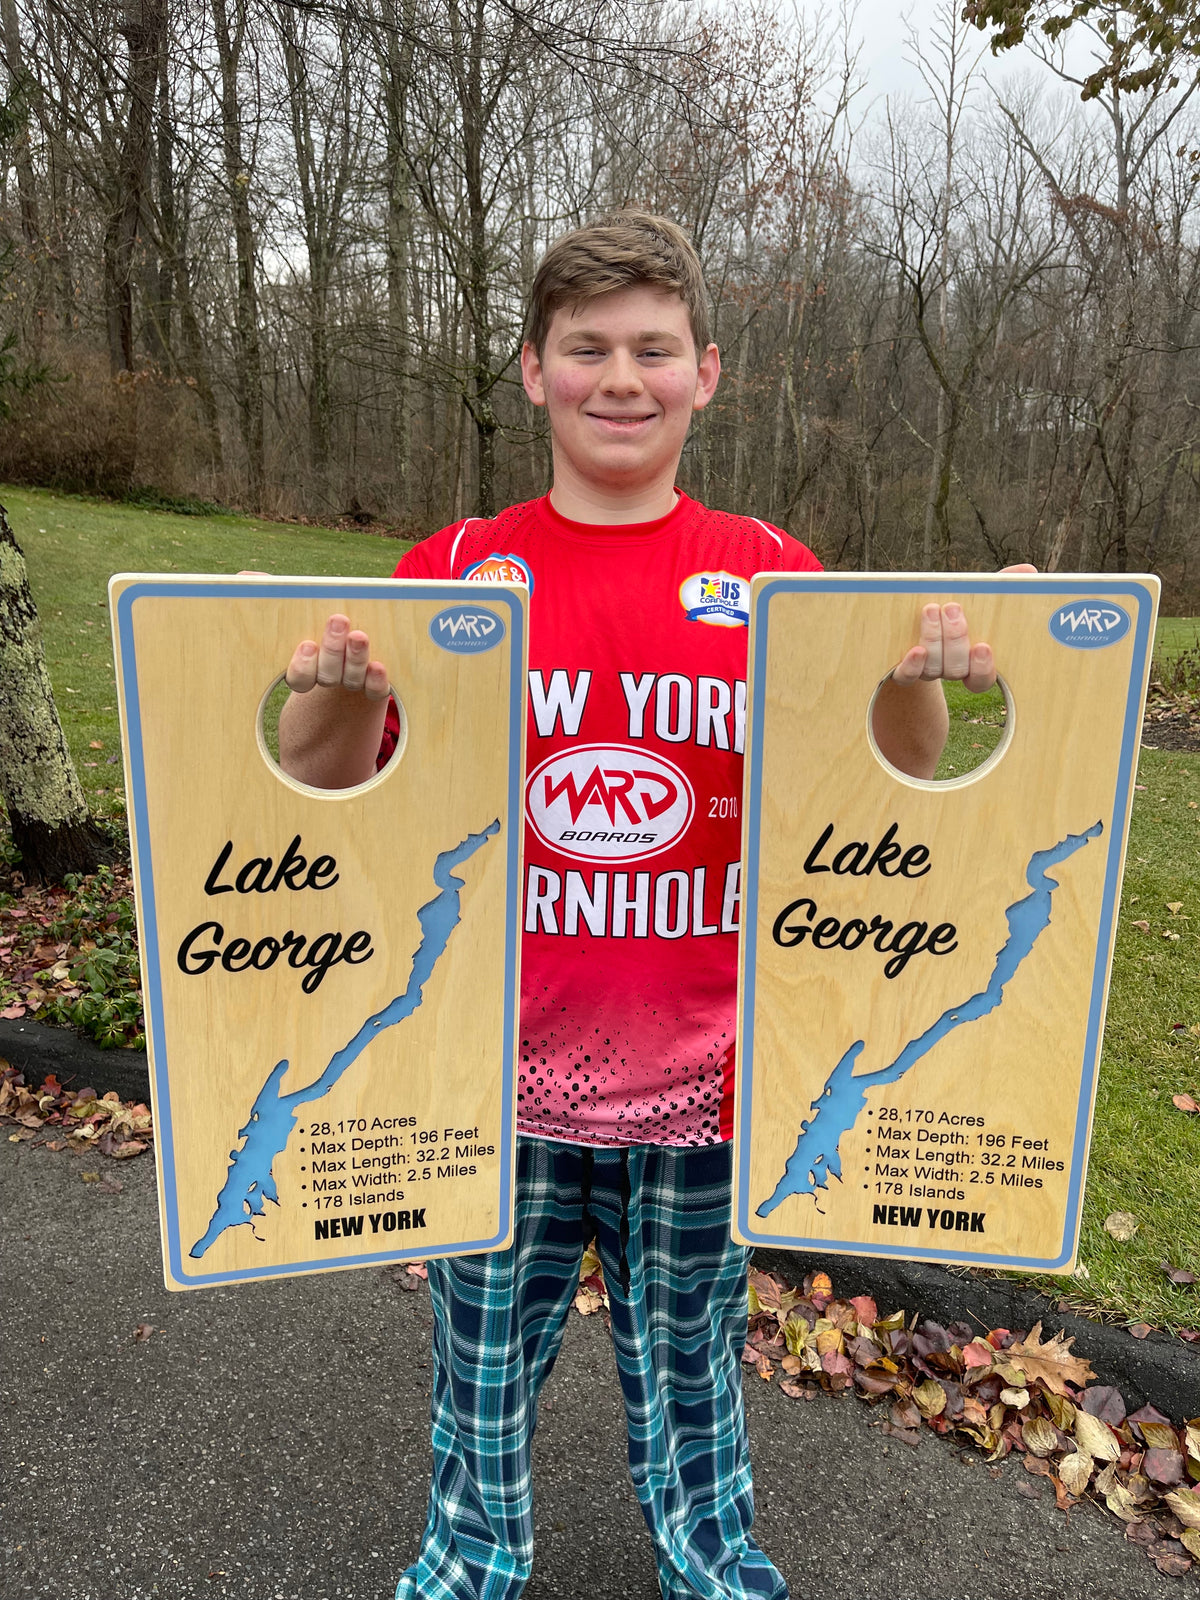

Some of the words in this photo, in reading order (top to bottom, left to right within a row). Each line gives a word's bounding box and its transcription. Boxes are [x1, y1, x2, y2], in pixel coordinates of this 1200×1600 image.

[721, 580, 740, 600] US
[438, 614, 496, 638] WARD
[1060, 608, 1121, 632] WARD
[544, 764, 678, 827] WARD
[559, 831, 657, 843] BOARDS
[803, 822, 932, 878] Lake
[204, 834, 340, 896] Lake
[772, 898, 958, 979] George
[177, 921, 374, 994] George
[310, 1118, 367, 1136] 28,170
[371, 1116, 417, 1130] Acres
[878, 1108, 934, 1124] 28,170
[938, 1112, 985, 1126] Acres
[311, 1142, 345, 1155] Max
[352, 1135, 403, 1153] Depth:
[410, 1131, 438, 1144] 196
[444, 1127, 479, 1141] Feet
[878, 1127, 911, 1141] Max
[917, 1129, 969, 1146] Depth:
[977, 1134, 1005, 1147] 196
[1012, 1136, 1048, 1150] Feet
[312, 1161, 346, 1173] Max
[352, 1152, 410, 1170] Length:
[416, 1148, 450, 1163] 32.2
[455, 1144, 495, 1158] Miles
[876, 1145, 910, 1159] Max
[916, 1147, 974, 1165] Length:
[981, 1153, 1016, 1167] 32.2
[1022, 1156, 1064, 1171] Miles
[313, 1180, 346, 1192] Max
[352, 1172, 401, 1187] Width:
[407, 1168, 431, 1181] 2.5
[437, 1164, 476, 1178] Miles
[875, 1164, 909, 1178] Max
[914, 1166, 963, 1182] Width:
[970, 1171, 994, 1184] 2.5
[1001, 1173, 1043, 1188] Miles
[314, 1196, 342, 1209] 178
[349, 1189, 404, 1206] Islands
[875, 1182, 903, 1195] 178
[909, 1184, 965, 1200] Islands
[315, 1215, 364, 1240] NEW
[368, 1208, 426, 1234] YORK
[873, 1204, 922, 1227] NEW
[927, 1208, 986, 1233] YORK
